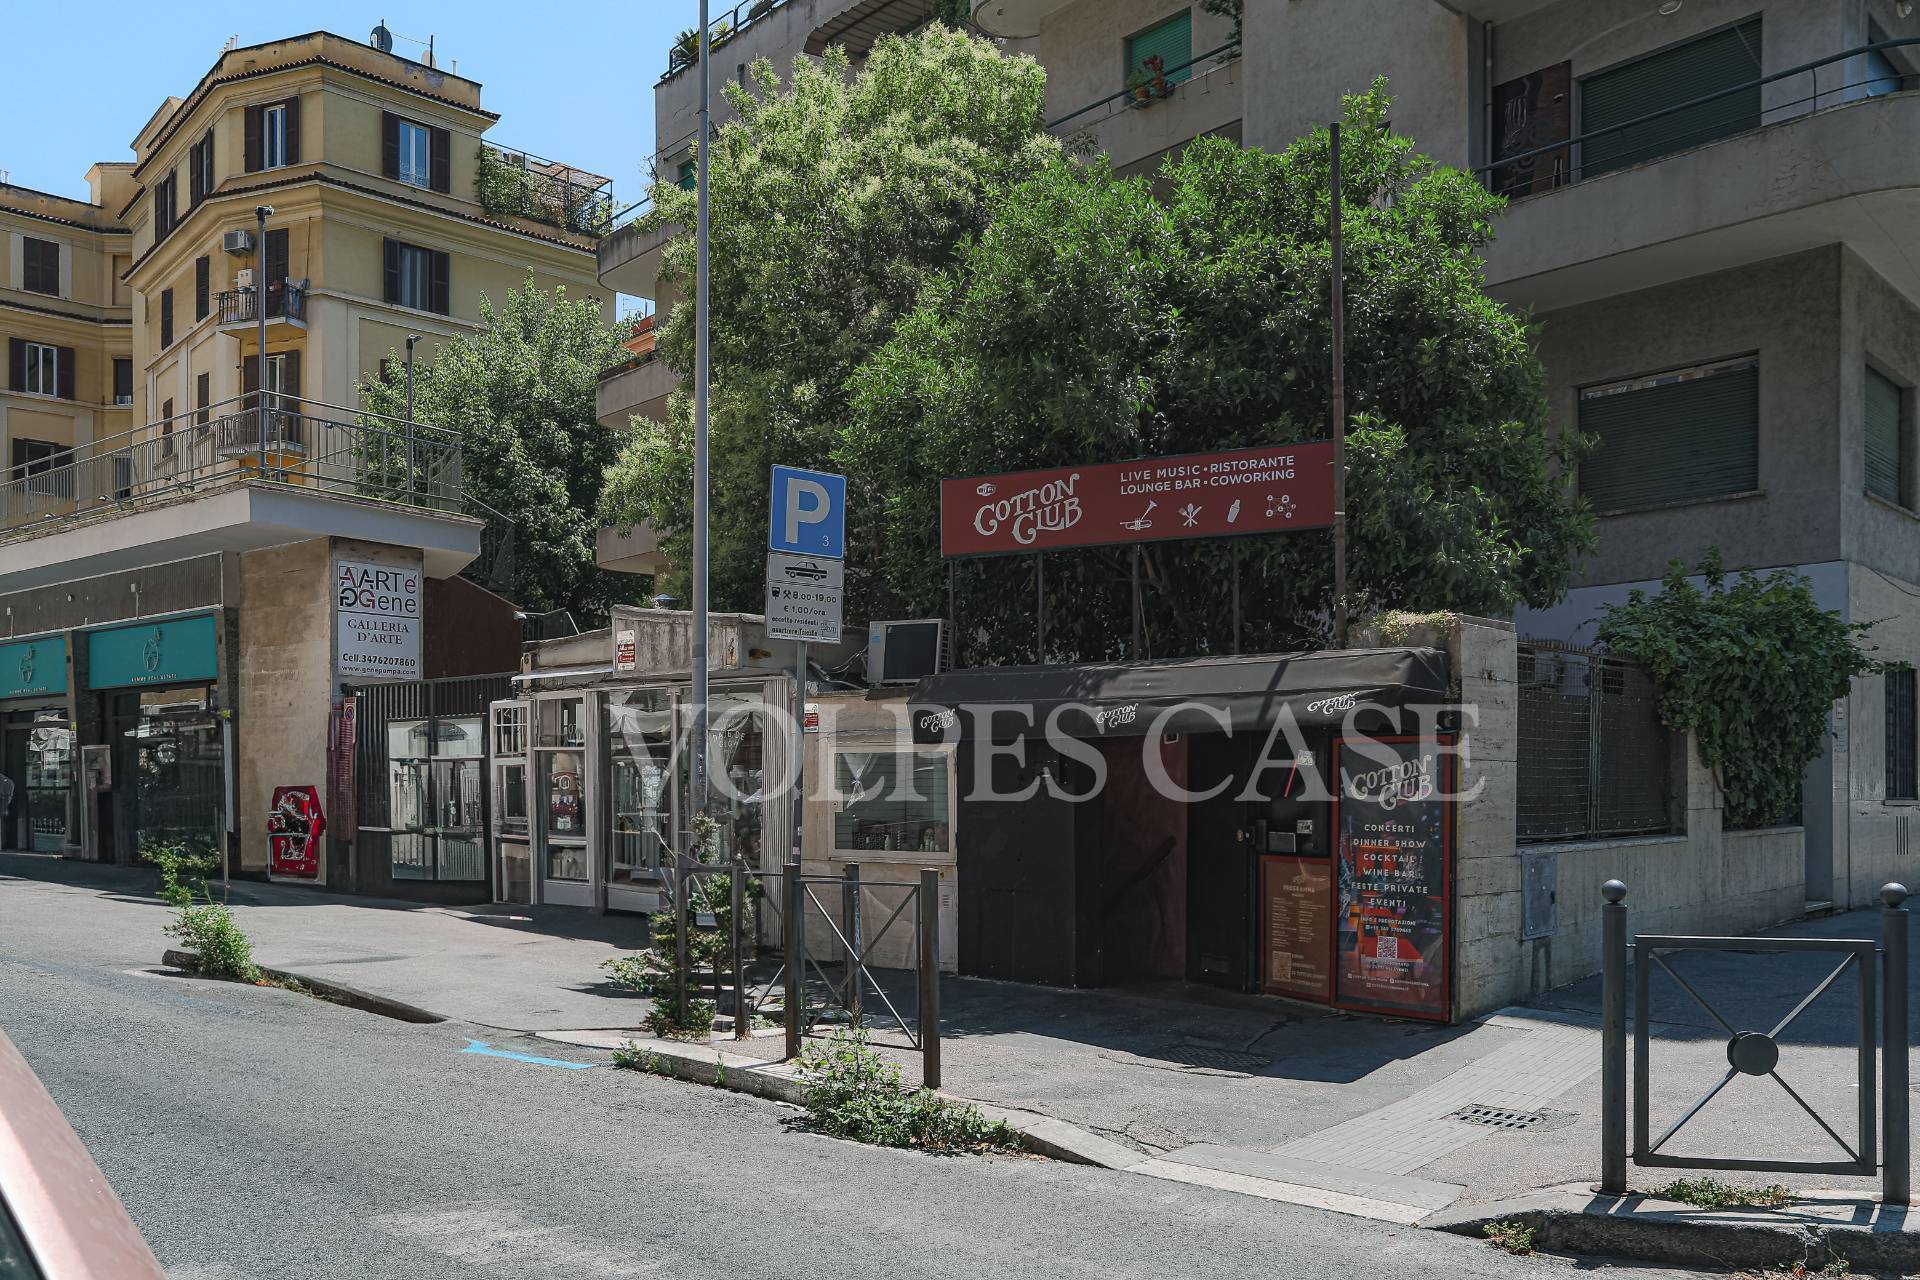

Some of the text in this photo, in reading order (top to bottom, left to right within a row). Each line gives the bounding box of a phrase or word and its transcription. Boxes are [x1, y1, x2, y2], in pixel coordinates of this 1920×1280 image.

[1120, 455, 1295, 482] LIVE MUSIC RISTORANTE
[1120, 469, 1295, 495] LOUNGE BAR COWORKING
[785, 477, 830, 544] P
[974, 473, 1080, 535] COTTON
[1012, 497, 1082, 544] CLUB
[822, 535, 829, 547] 3
[347, 618, 409, 633] GALLERIA
[357, 632, 403, 645] D'ARTE
[1350, 754, 1432, 800] COTTON
[1378, 774, 1433, 811] CLUB
[1364, 824, 1415, 833] CONCERTI
[1353, 838, 1427, 849] DINNER SHOW
[1363, 853, 1415, 863] COCKTAIL
[1363, 867, 1416, 878] WINE BAR
[1351, 881, 1428, 894] FESTE PRIVATE
[1370, 898, 1406, 907] EVENTI
